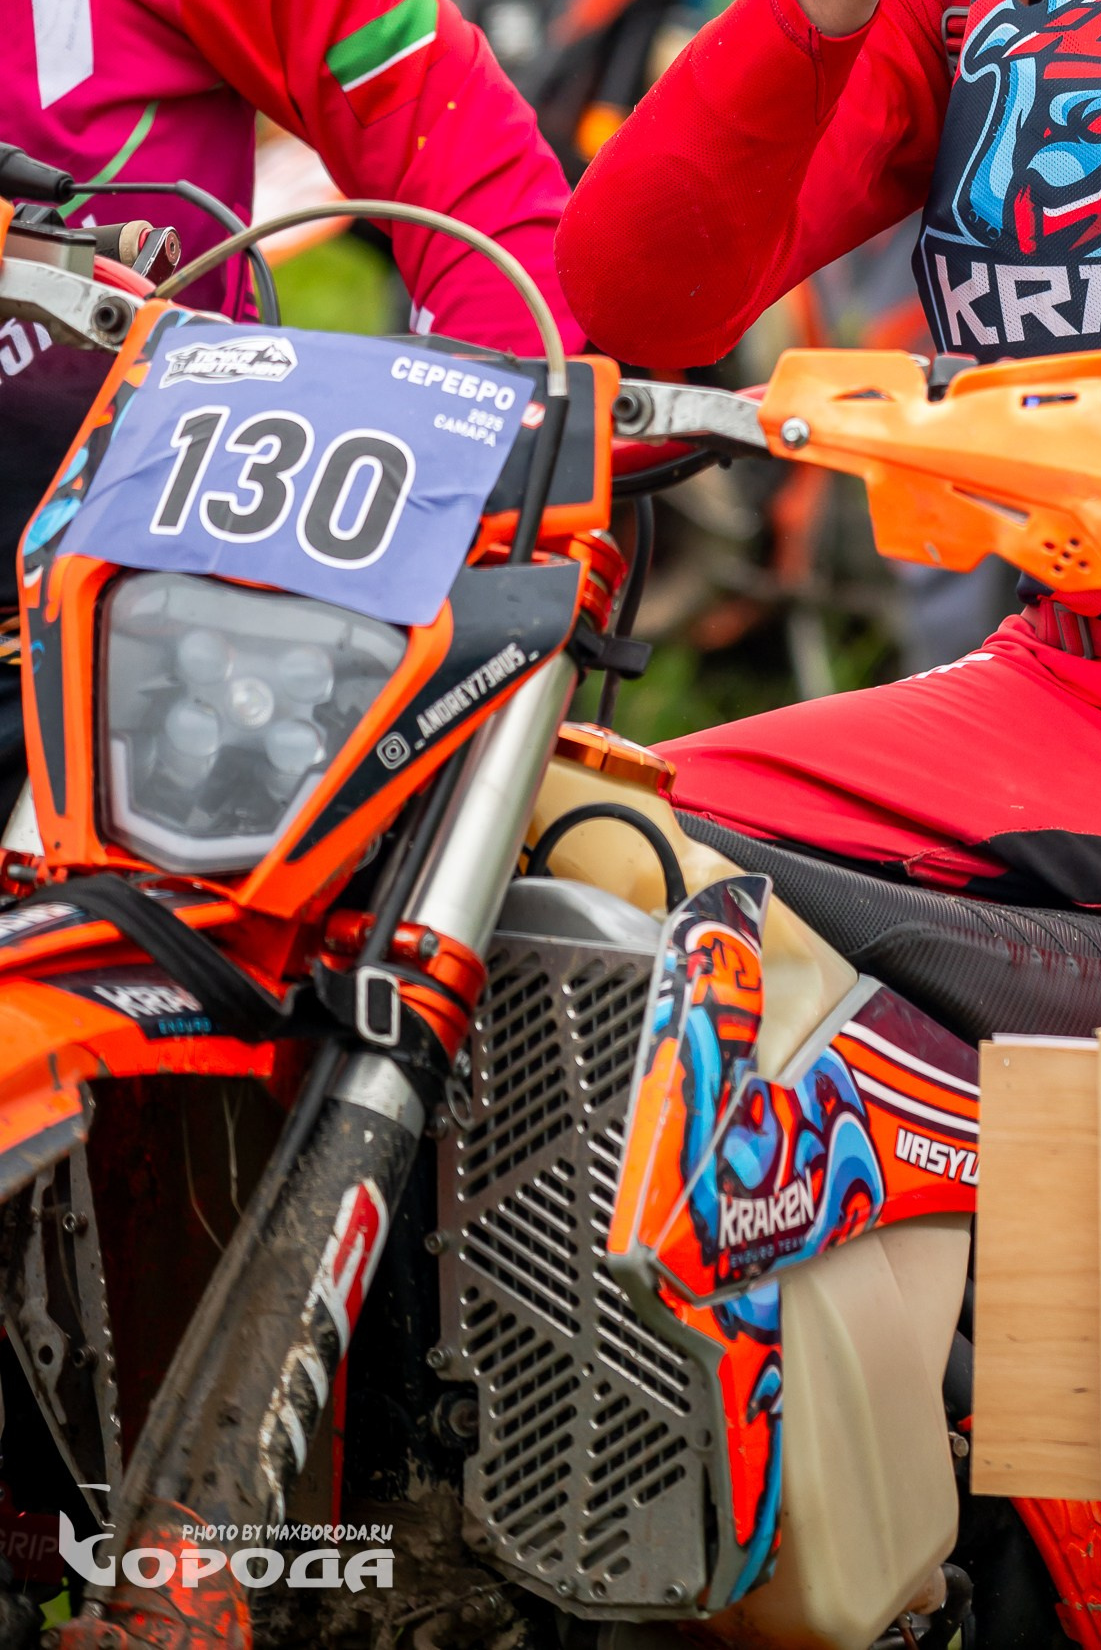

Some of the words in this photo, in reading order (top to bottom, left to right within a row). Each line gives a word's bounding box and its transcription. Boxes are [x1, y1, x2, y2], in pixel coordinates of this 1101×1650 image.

[391, 356, 516, 411] СЕРЕБРО
[433, 413, 496, 447] САМАРА
[468, 408, 504, 432] 2025
[150, 405, 415, 568] 130
